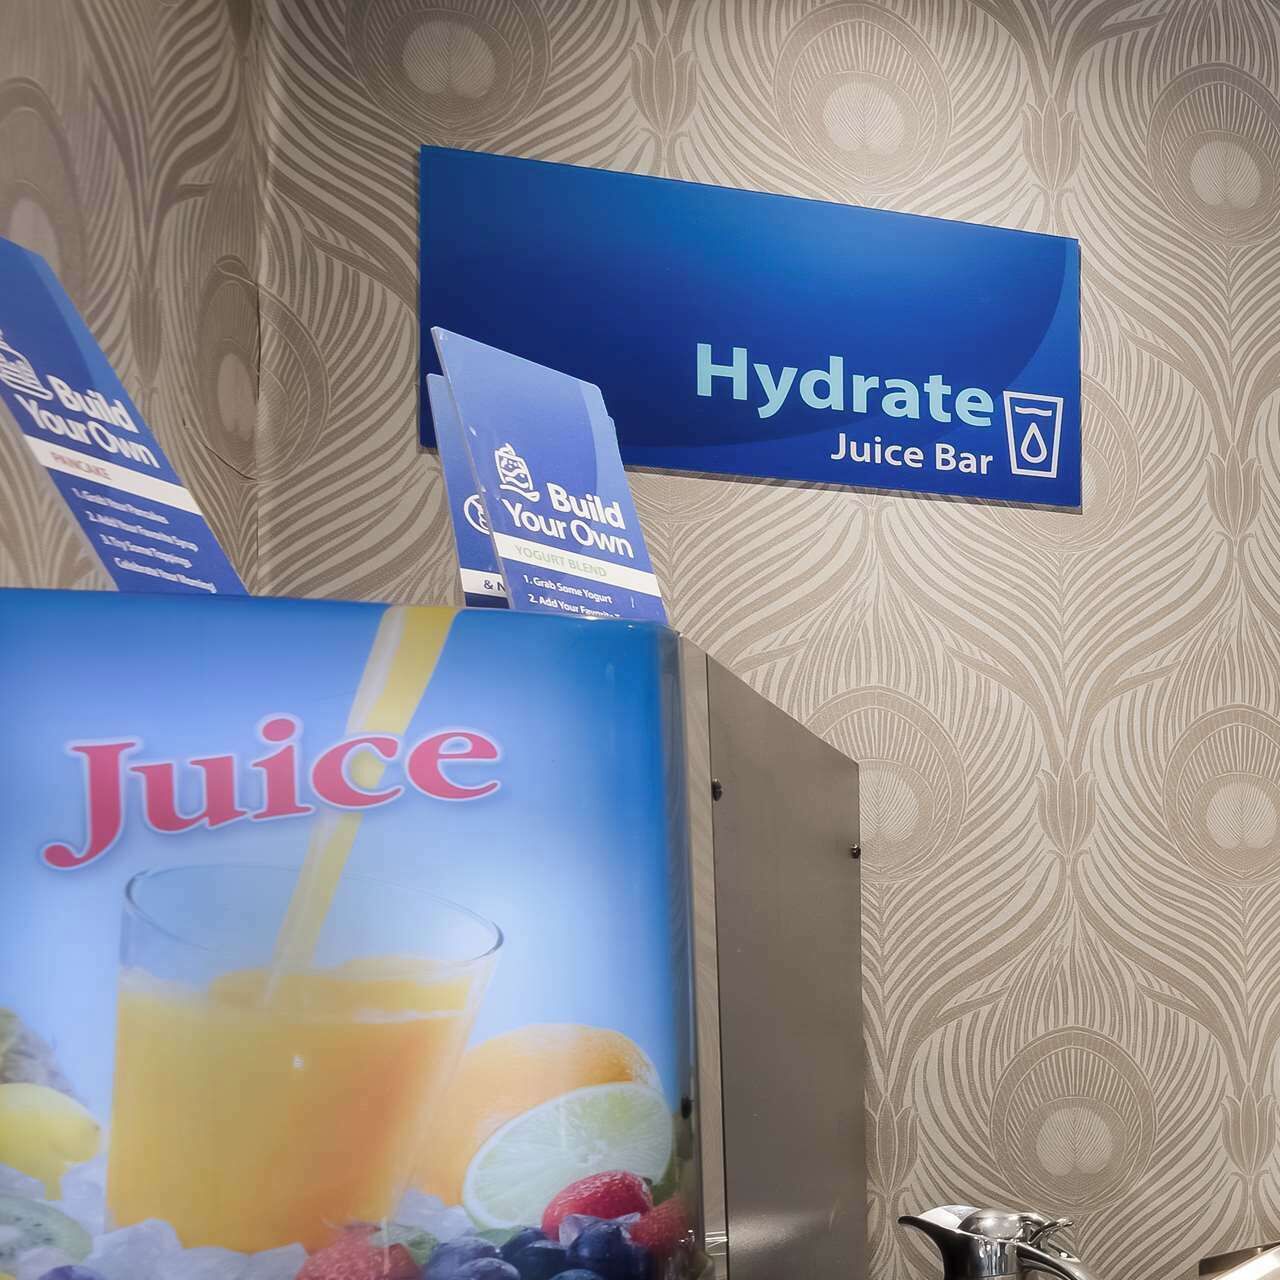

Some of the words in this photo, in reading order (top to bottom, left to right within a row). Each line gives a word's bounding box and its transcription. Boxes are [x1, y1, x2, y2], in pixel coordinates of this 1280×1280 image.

[47, 374, 140, 434] Build
[696, 342, 995, 428] Hydrate
[14, 393, 92, 445] Your
[88, 420, 161, 469] Own
[831, 433, 925, 469] Juice
[934, 443, 994, 475] Bar
[501, 498, 567, 540] Your
[569, 519, 635, 559] Own
[546, 482, 627, 530] Build
[515, 545, 566, 568] YOGURT
[567, 555, 608, 578] BLEND
[539, 596, 559, 609] Add
[558, 601, 580, 614] Your
[556, 582, 583, 598] Some
[582, 588, 613, 604] Yogurt
[42, 716, 499, 869] Juice
